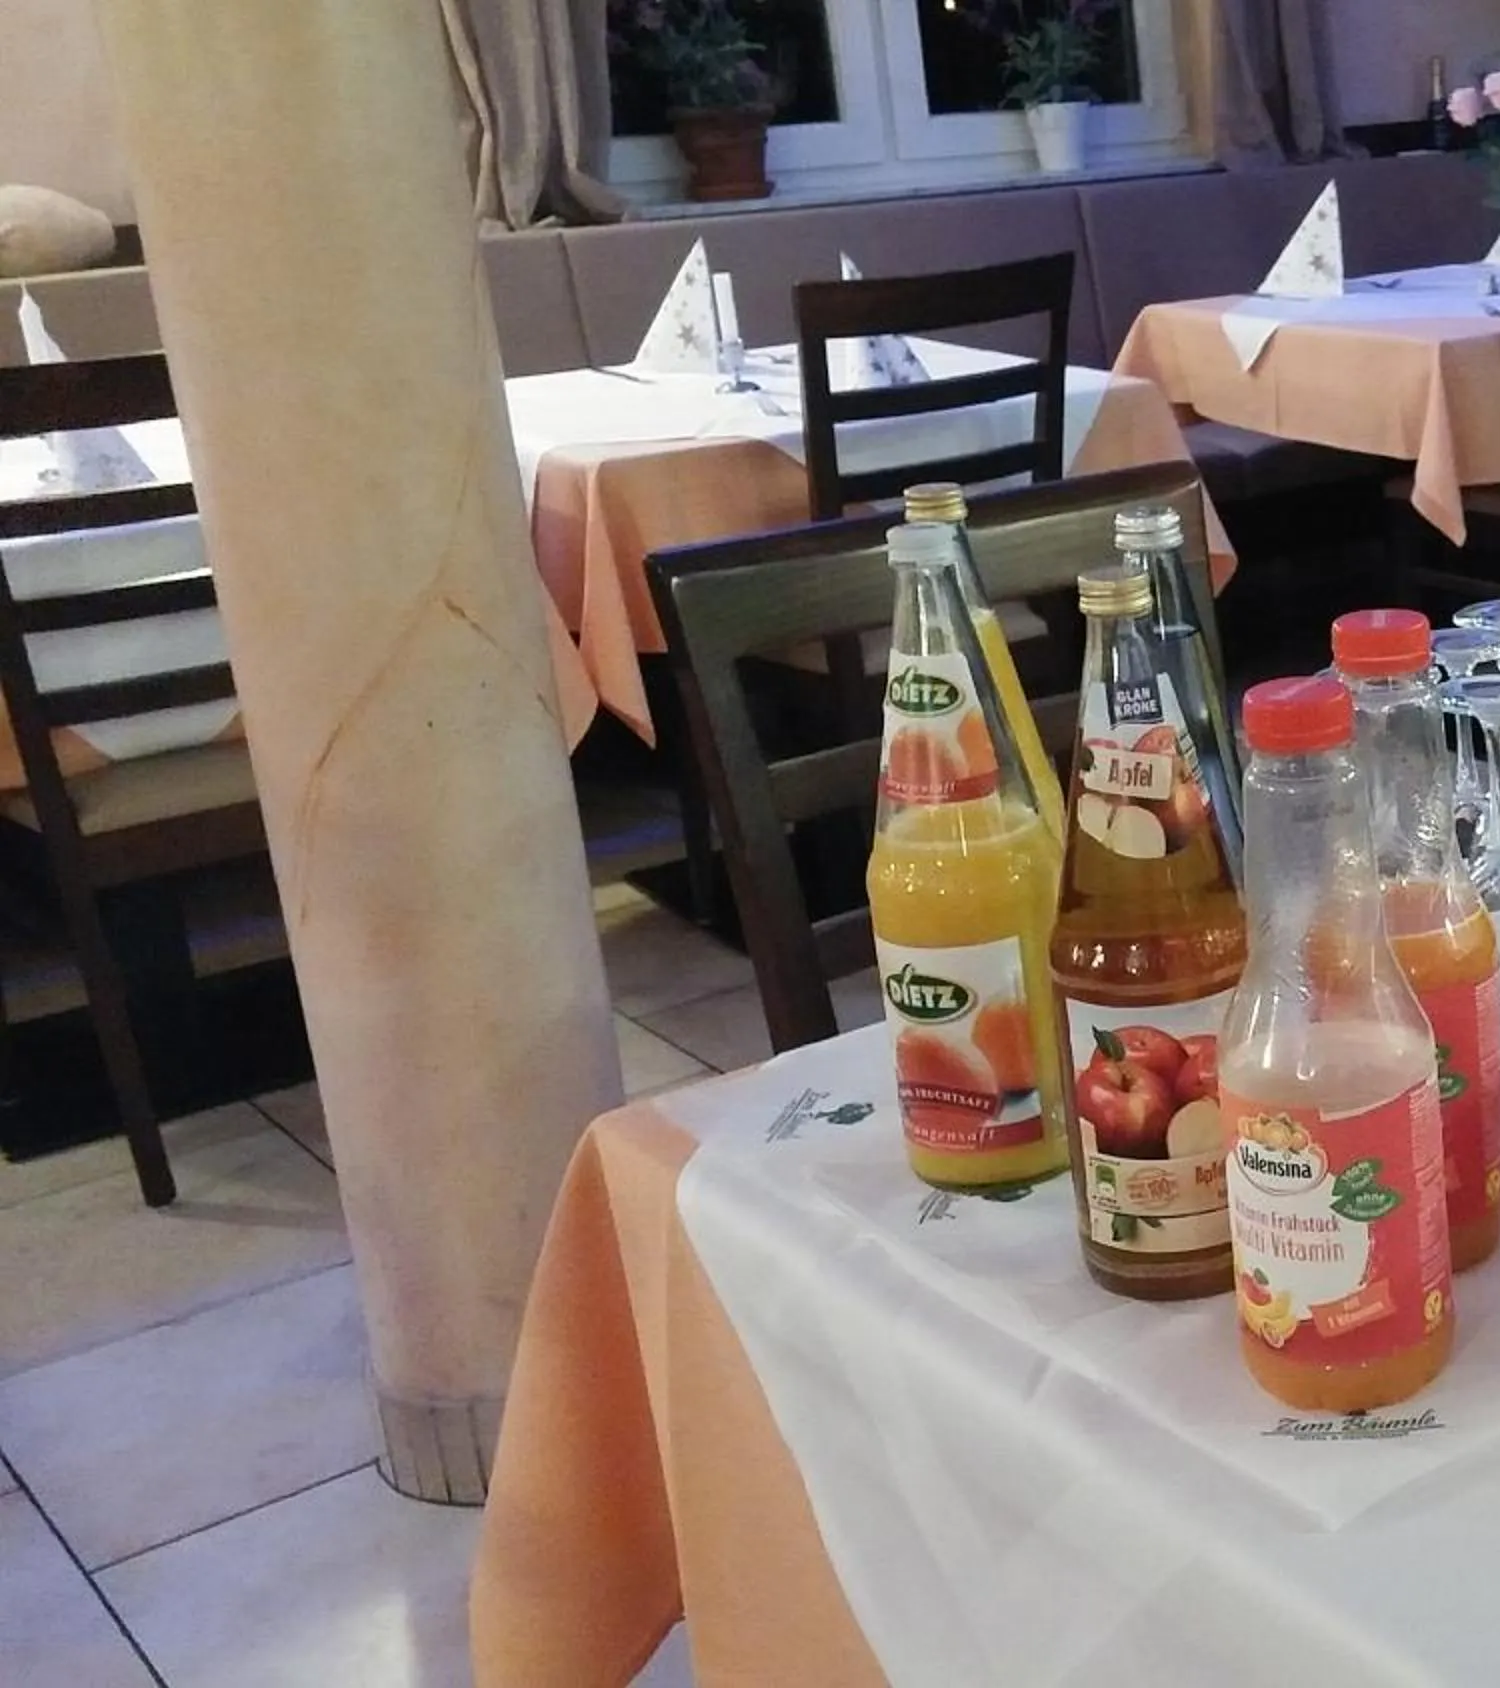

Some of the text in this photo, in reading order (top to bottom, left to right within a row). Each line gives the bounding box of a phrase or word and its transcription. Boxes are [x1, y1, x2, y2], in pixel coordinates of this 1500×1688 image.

[891, 674, 950, 705] DIETZ
[1108, 758, 1153, 791] Apfel
[889, 972, 958, 1009] DIETZ
[1240, 1145, 1312, 1179] Valensina
[1271, 1231, 1345, 1262] Vitamin
